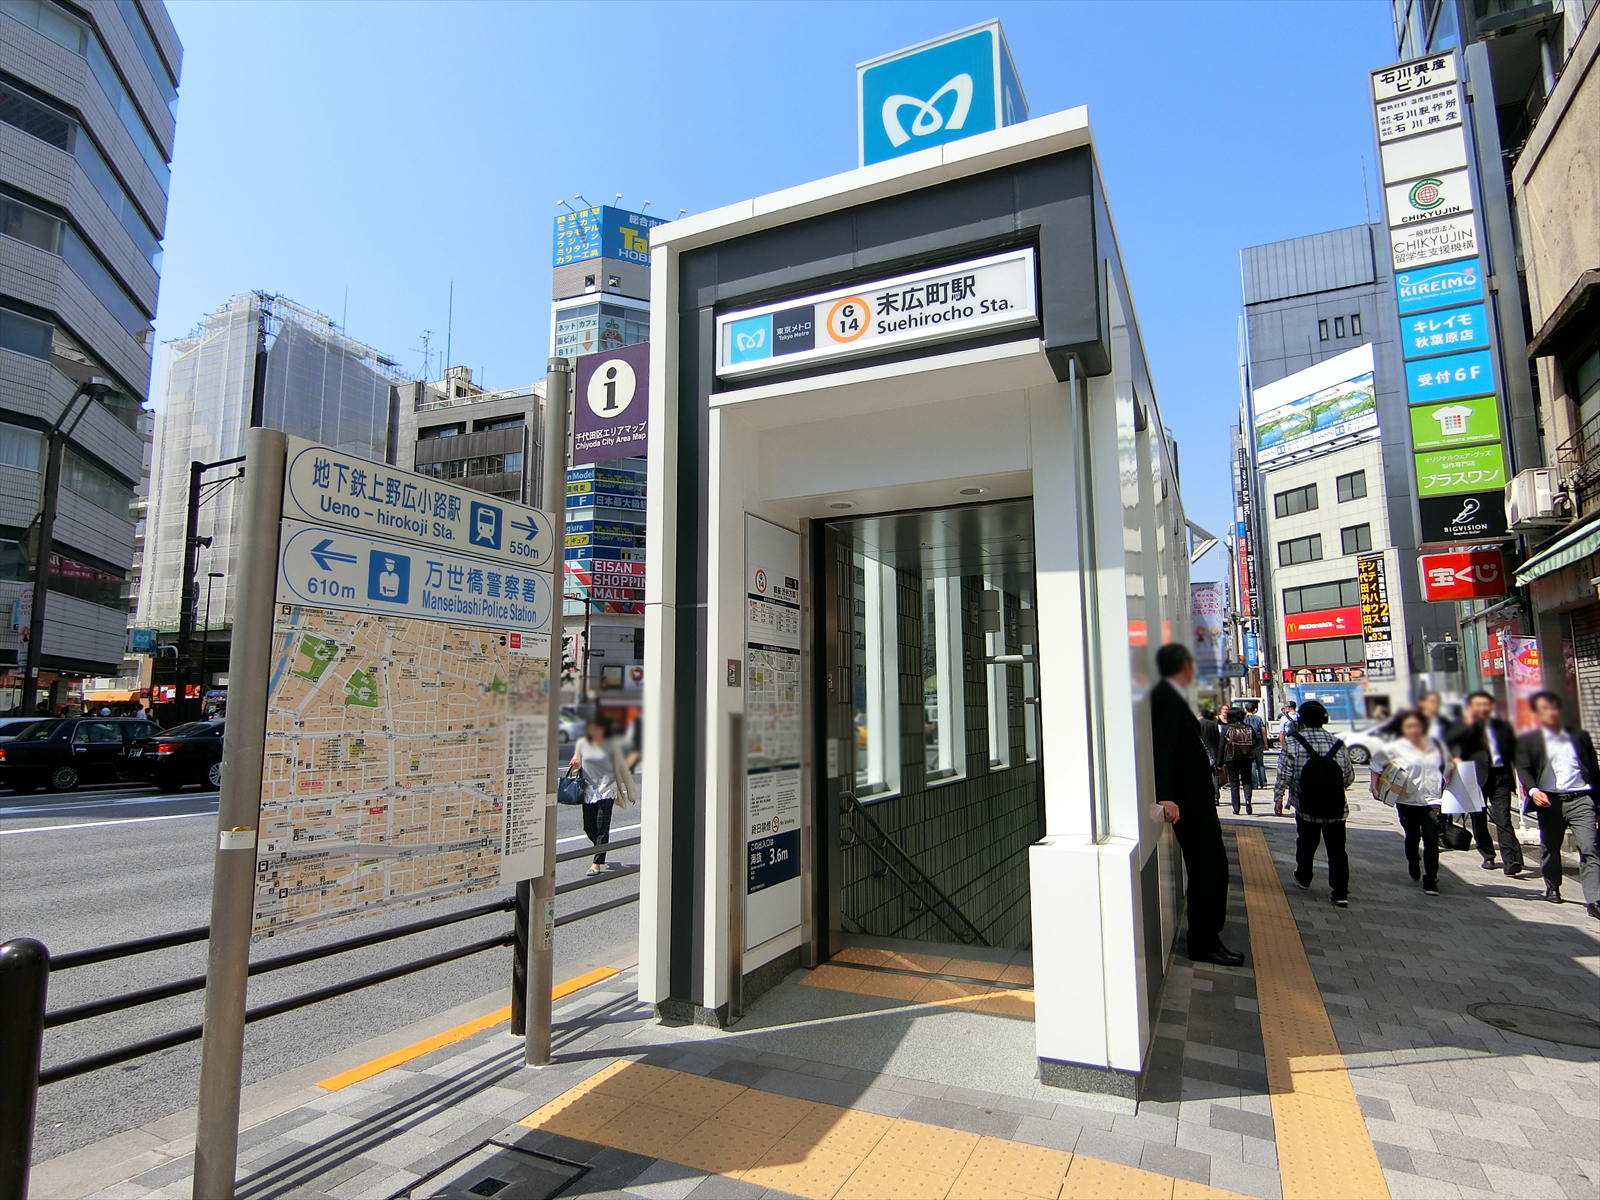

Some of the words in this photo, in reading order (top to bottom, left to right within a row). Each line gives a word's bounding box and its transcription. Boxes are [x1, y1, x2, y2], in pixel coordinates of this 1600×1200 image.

[1380, 58, 1446, 84] 石川興産
[1397, 76, 1431, 92] ビル
[1402, 206, 1460, 222] CHIKYUJIN
[1408, 224, 1455, 237] 一般財団法人
[1394, 229, 1472, 253] CHIKYUJIN
[1395, 240, 1474, 263] 留学生支援機構
[876, 274, 976, 316] 末広町駅
[1400, 275, 1476, 297] KIREIMO
[843, 304, 854, 318] G
[878, 306, 974, 334] Suehirocho
[980, 297, 1013, 314] Sta.
[558, 320, 597, 332] ネットカフェ
[777, 322, 811, 335] 東京メトロ
[840, 318, 859, 334] 14
[1414, 314, 1472, 332] キレイモ
[1415, 330, 1473, 348] 秋葉原店
[576, 421, 647, 442] 千代田区エリアマップ
[576, 438, 600, 450] Chiyoda
[602, 437, 614, 446] City
[616, 435, 630, 443] Area
[632, 432, 646, 441] Map
[573, 470, 594, 480] Model
[1422, 470, 1499, 488] プラスワン
[312, 457, 462, 523] 地下鉄上野広小路駅
[432, 523, 455, 540] Sta.
[1444, 524, 1487, 532] BIGVISION
[510, 540, 539, 560] 550m
[595, 560, 632, 573] EISAN
[1428, 563, 1498, 587] 宝くじ
[308, 578, 355, 599] 610m
[425, 560, 536, 603] 万世橋警察署
[594, 588, 629, 600] MALL
[1358, 562, 1372, 625] 千代田外神田
[1367, 562, 1380, 623] シティハウス
[422, 590, 482, 617] Manseibashi
[482, 600, 508, 618] Police
[510, 604, 537, 623] Station
[752, 821, 771, 835] 終日禁煙
[751, 839, 774, 851] この出入口は
[769, 848, 788, 865] 3.6m
